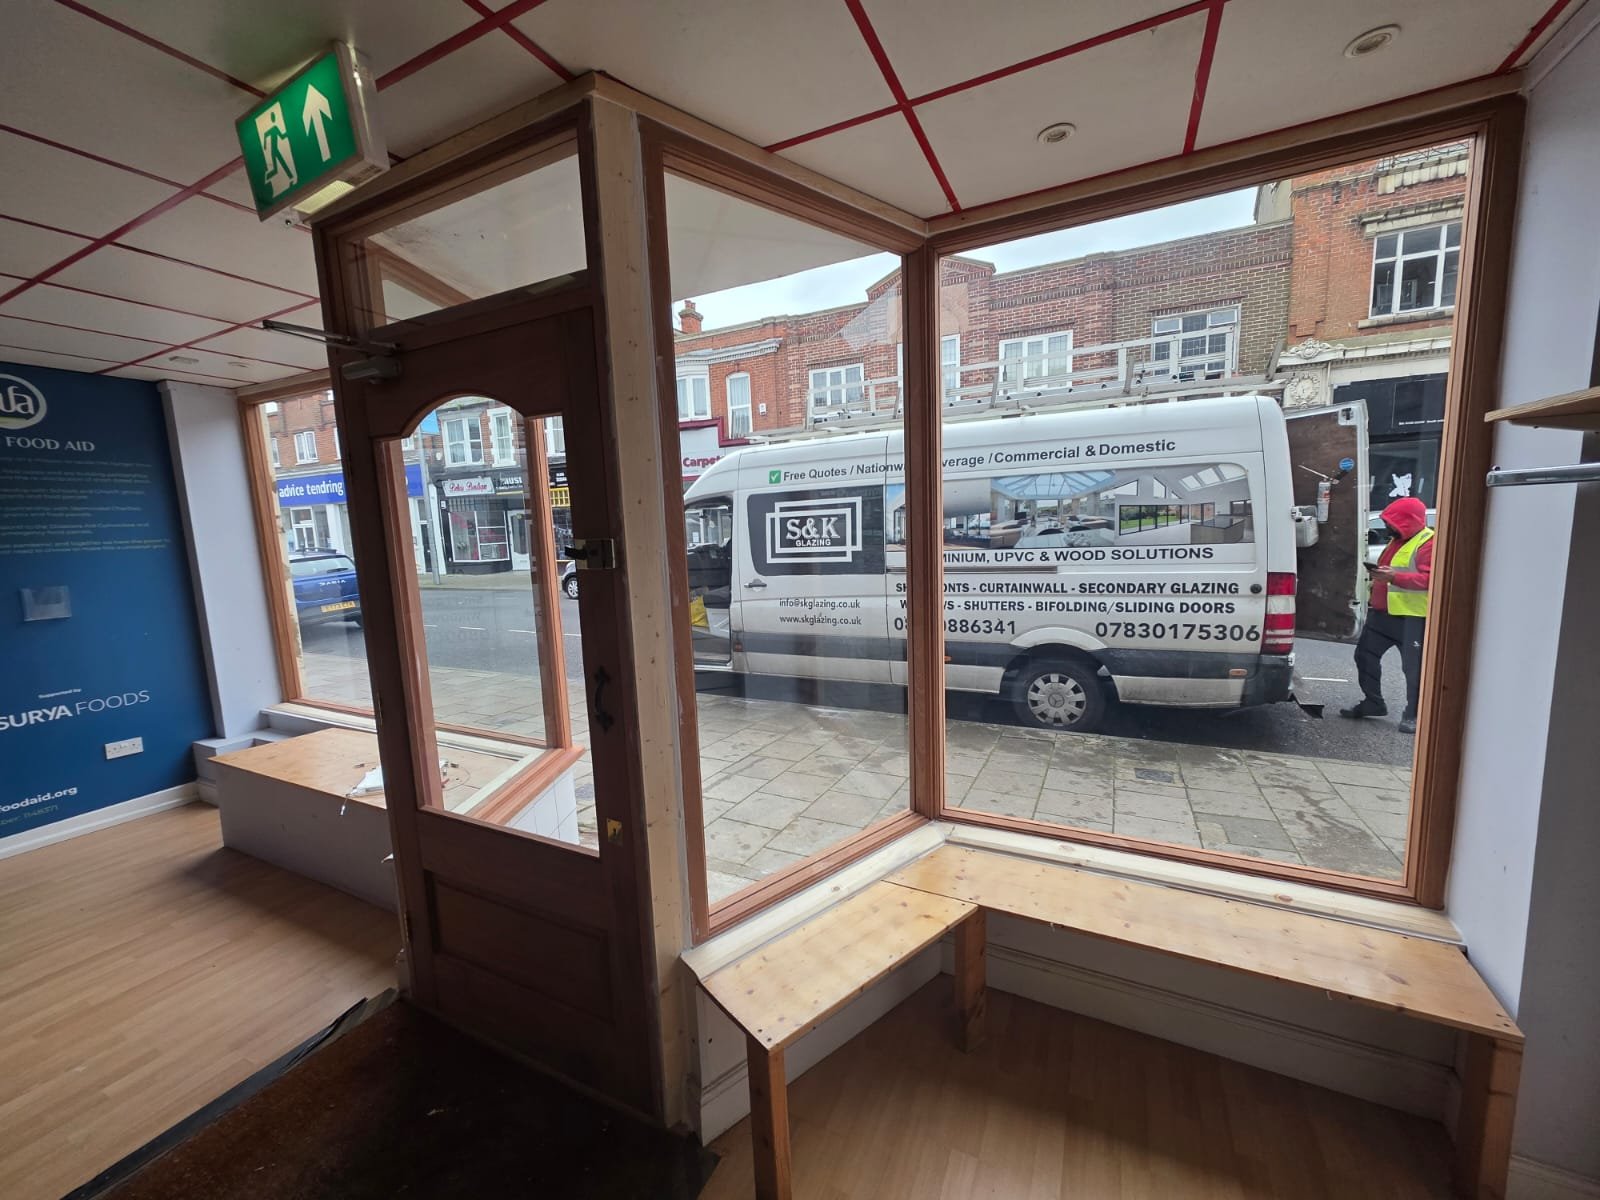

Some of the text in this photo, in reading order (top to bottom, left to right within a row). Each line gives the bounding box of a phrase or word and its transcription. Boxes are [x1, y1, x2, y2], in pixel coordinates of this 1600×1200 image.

[5, 436, 95, 452] FOOD AID
[783, 471, 806, 482] Free
[809, 468, 847, 479] Quotes
[856, 463, 905, 475] Nationw
[942, 456, 984, 468] verage
[994, 446, 1080, 463] Commercial
[1085, 444, 1097, 457] &
[1099, 439, 1176, 456] Domestic
[279, 480, 344, 498] advice tendring
[786, 517, 841, 540] S&K
[795, 539, 831, 547] GLAZING
[994, 550, 1035, 563] UPVC
[1039, 549, 1050, 562] &
[1054, 548, 1106, 562] WOOD
[1111, 546, 1214, 561] SOLUTIONS
[979, 582, 1068, 595] CURTAINWALL
[1078, 582, 1167, 595] SECONDARY
[1170, 582, 1239, 595] GLAZING
[779, 597, 861, 610] info@skglazing.co.uk
[964, 600, 1025, 612] SHUTTERS
[1035, 601, 1175, 615] BIFOLDING/SLIDING
[1179, 601, 1236, 615] DOORS
[779, 615, 862, 626] www.skglazing.co.uk
[1095, 622, 1260, 642] 07830175306
[0, 689, 151, 731] SURYA FOODS
